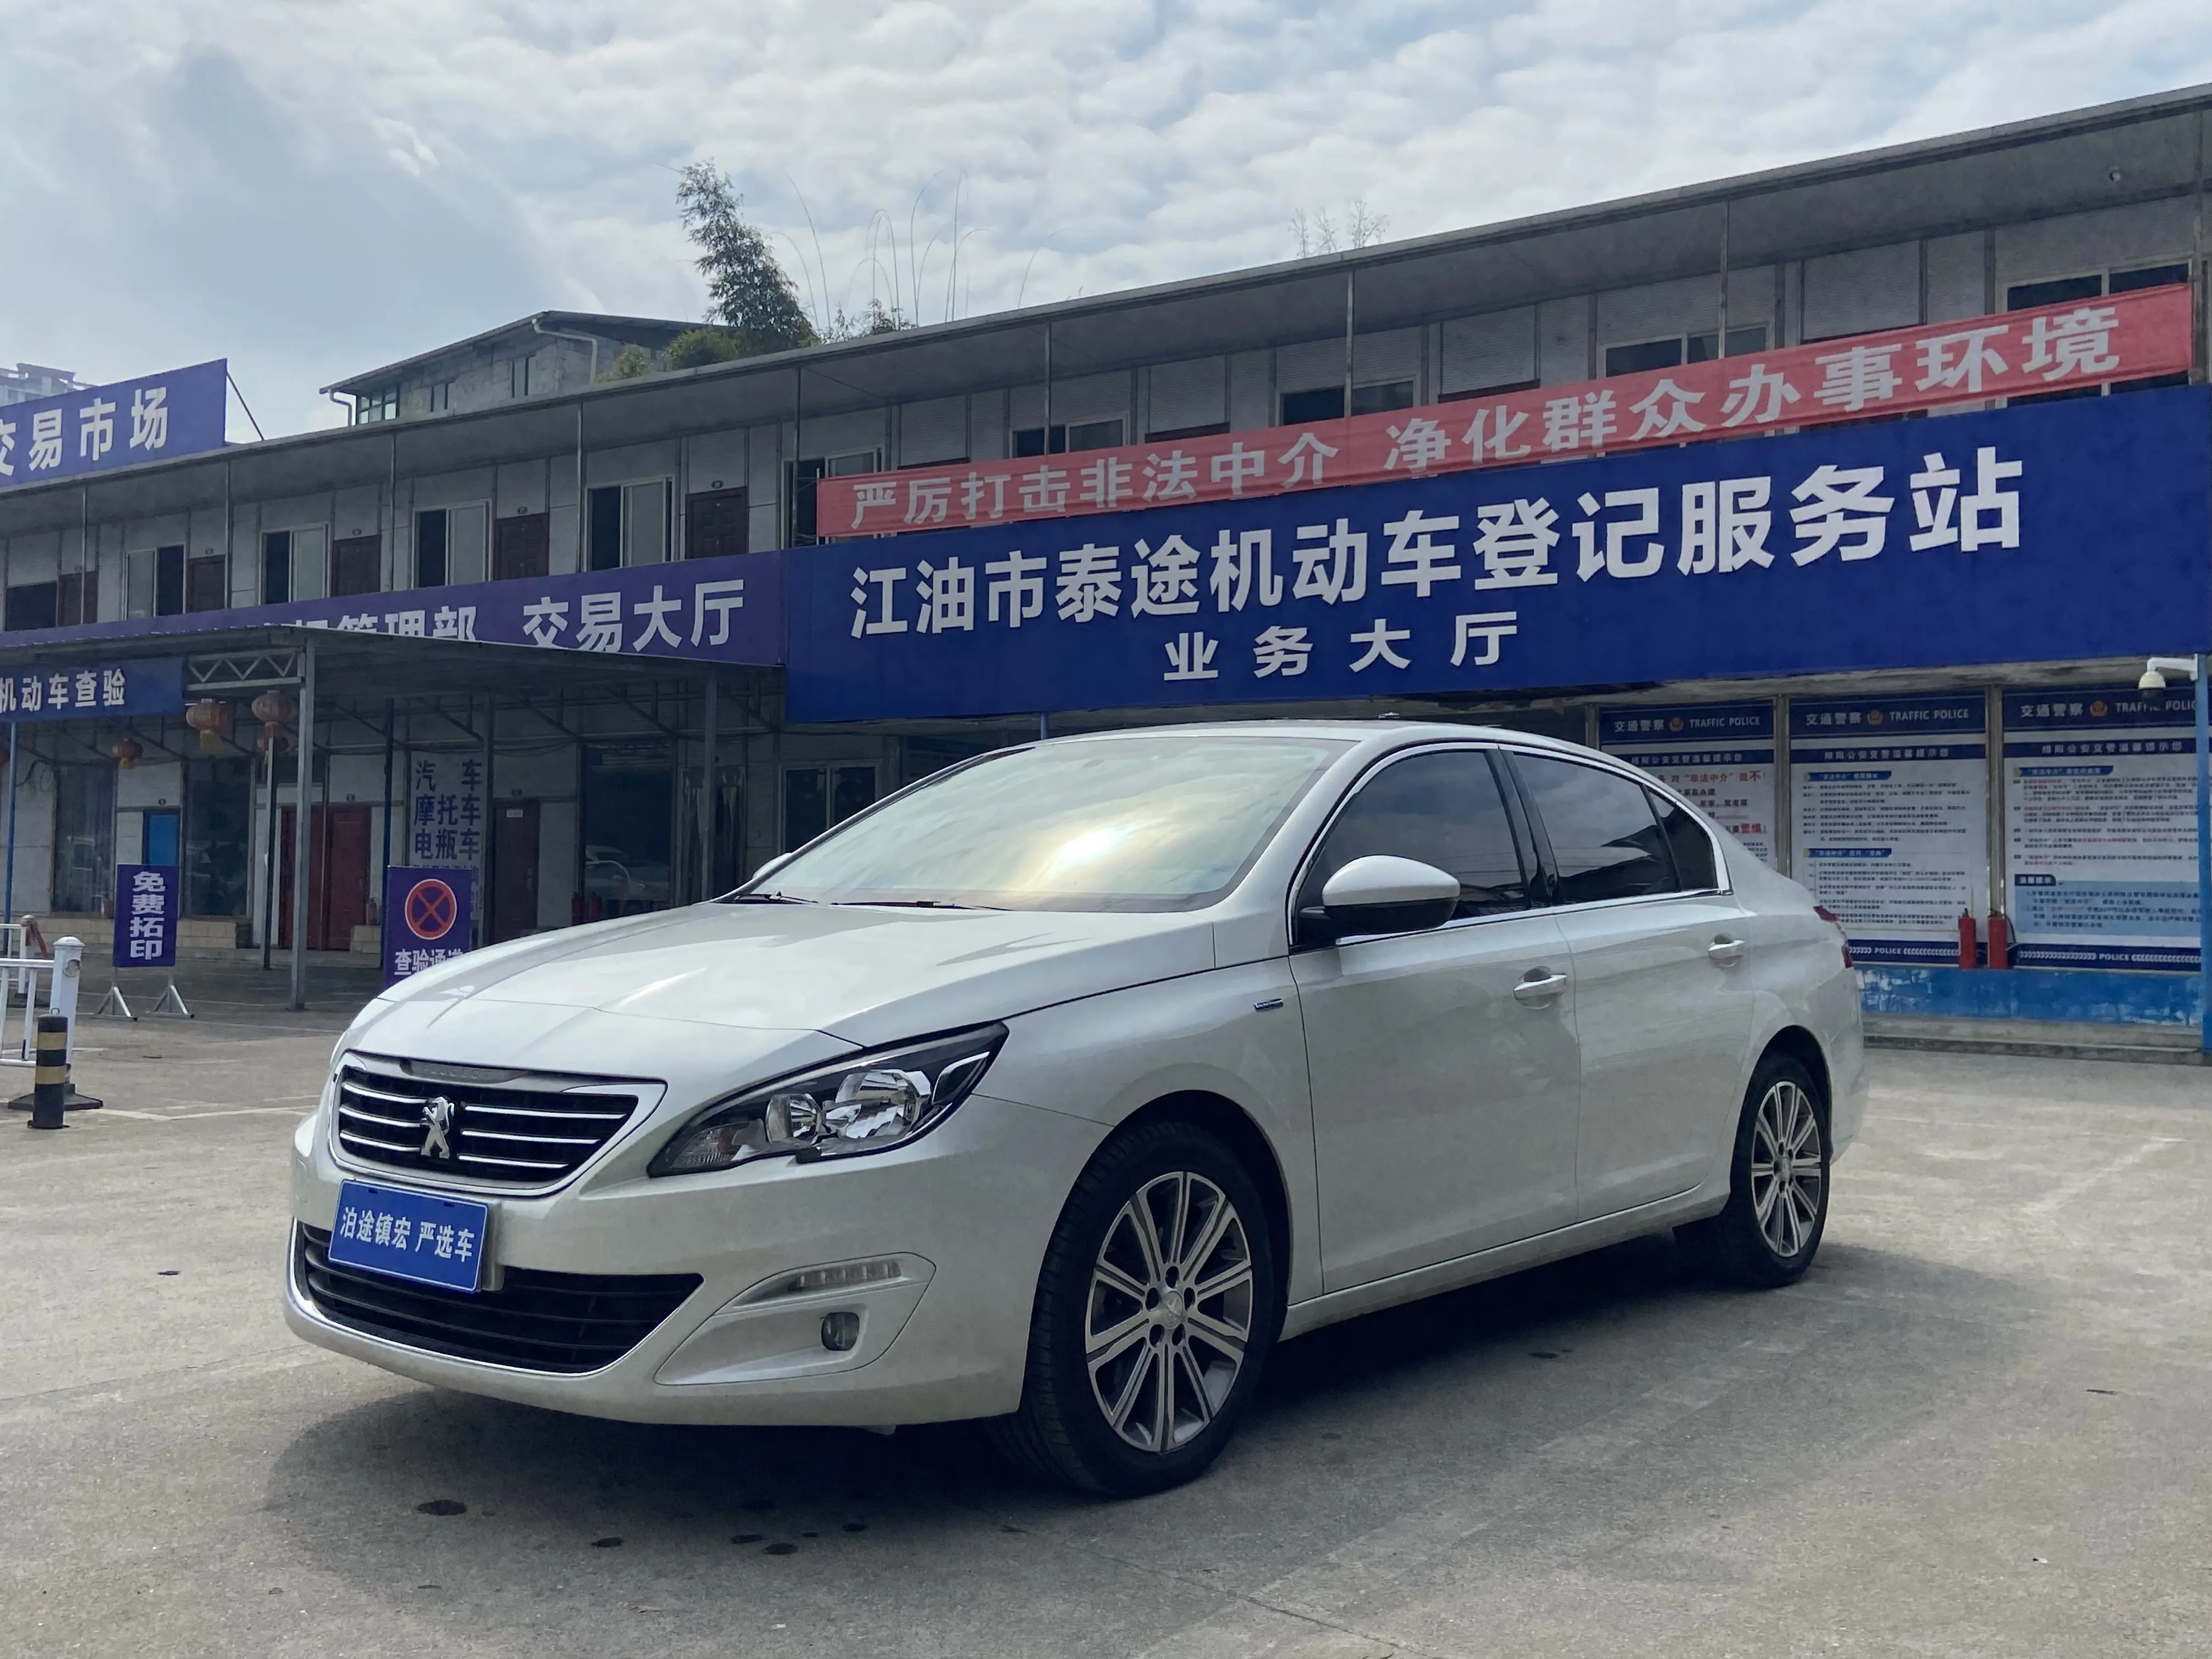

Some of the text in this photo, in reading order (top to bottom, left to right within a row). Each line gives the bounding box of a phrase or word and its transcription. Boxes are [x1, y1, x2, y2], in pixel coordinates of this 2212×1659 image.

[851, 306, 2121, 529] 严厉打击非法中介 净化群众办事环境
[850, 447, 2023, 639] 江油市泰途机动车登记服务站
[522, 579, 744, 653] 交易大厅
[1163, 611, 1517, 681] 业务大厅
[0, 668, 126, 713] 机动车查验
[2115, 700, 2196, 713] TRAFF POLIC
[1615, 719, 1664, 732] 交通警察
[1690, 716, 1761, 729] TRAFFIC POLICE
[1806, 712, 1861, 726] 交通警察
[1889, 708, 1970, 721] TRAFFIC POLICE
[2021, 702, 2083, 718] 交通警察
[414, 793, 481, 826] 摩托车
[415, 827, 480, 861] 电瓶车
[129, 871, 166, 961] 免费拓印
[2098, 953, 2129, 962] POLICE
[339, 1206, 475, 1263] 泊途镇宏 严选车
